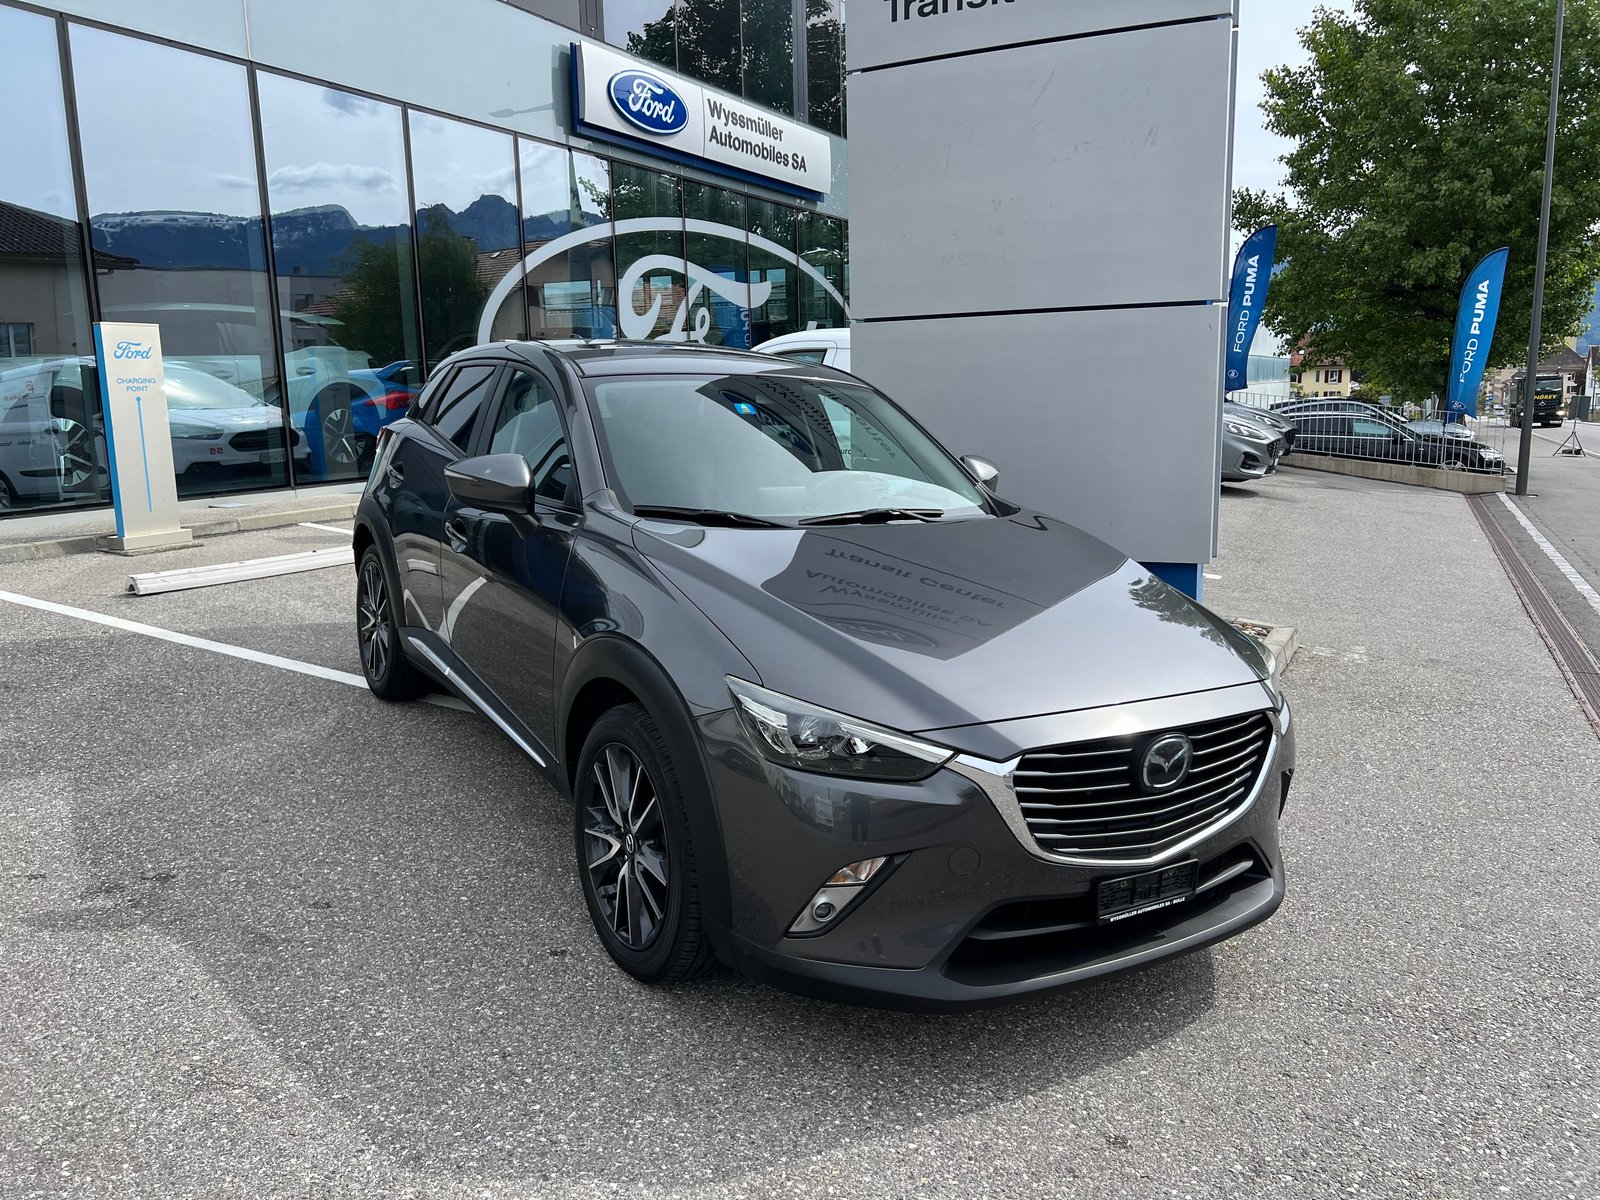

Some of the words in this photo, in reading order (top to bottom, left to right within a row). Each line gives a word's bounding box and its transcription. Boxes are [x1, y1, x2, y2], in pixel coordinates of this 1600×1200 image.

[628, 78, 675, 124] Ford
[707, 98, 783, 142] Wyssmüller
[709, 125, 790, 168] Automobiles
[791, 154, 807, 173] SA
[1233, 310, 1250, 353] FORD
[1242, 255, 1260, 307] PUMA
[113, 341, 152, 359] Ford
[1460, 338, 1479, 383] FORD
[1470, 279, 1490, 335] PUMA
[1138, 902, 1165, 914] AUTOMOBILES
